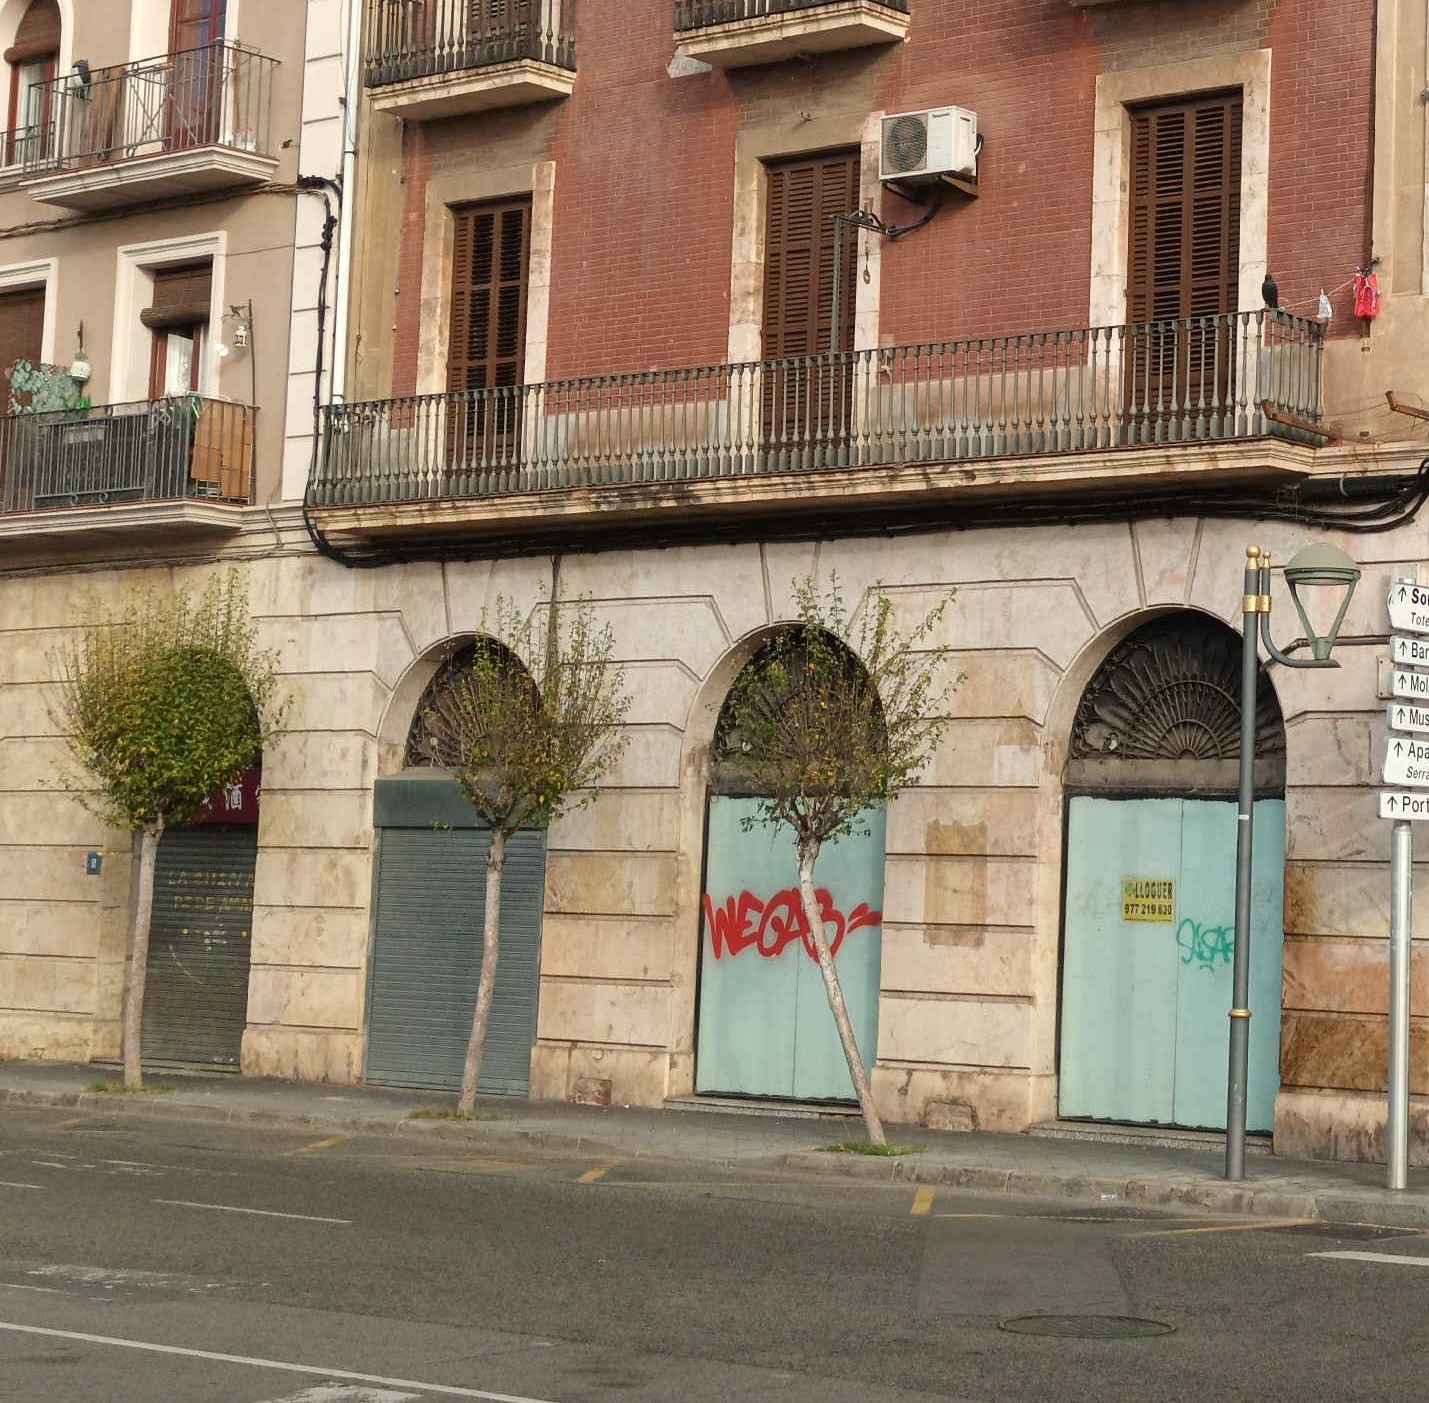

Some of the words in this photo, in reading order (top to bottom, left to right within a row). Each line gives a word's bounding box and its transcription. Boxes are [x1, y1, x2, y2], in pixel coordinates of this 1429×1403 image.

[1135, 882, 1173, 899] LLOGUER
[1124, 904, 1139, 914] 977
[1141, 904, 1156, 915] 219
[1158, 905, 1172, 915] 830
